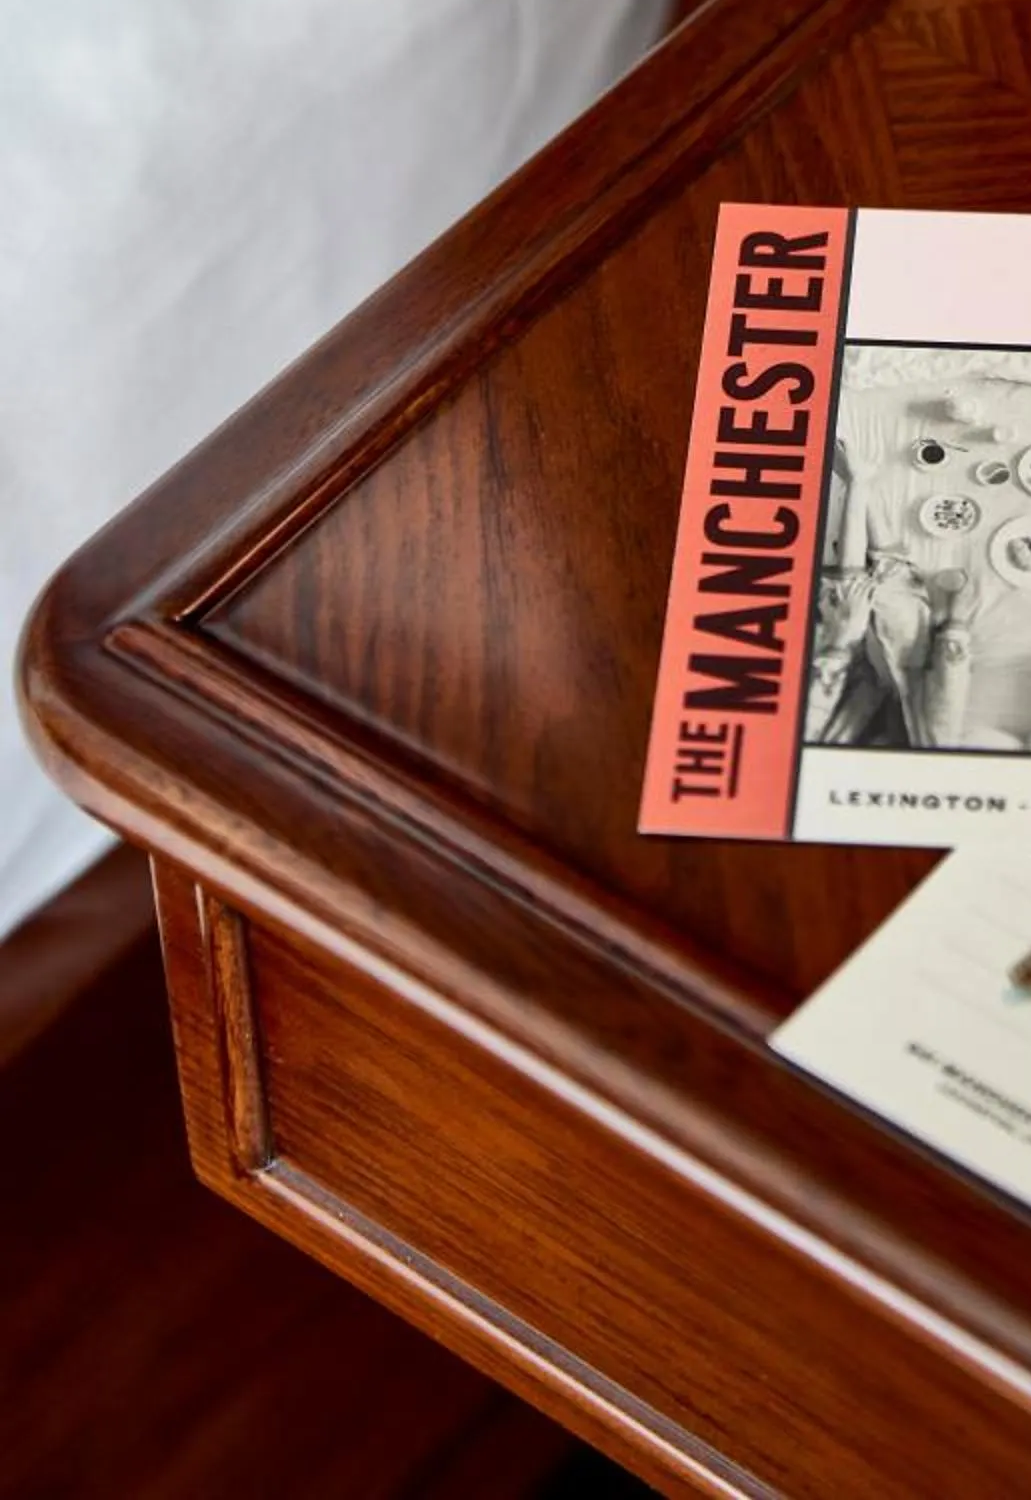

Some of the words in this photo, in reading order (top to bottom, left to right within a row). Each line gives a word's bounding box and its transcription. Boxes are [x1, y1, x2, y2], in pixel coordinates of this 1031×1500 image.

[684, 230, 829, 715] MANCHESTER
[672, 721, 728, 803] THE
[828, 790, 1007, 813] LEXINGTON
